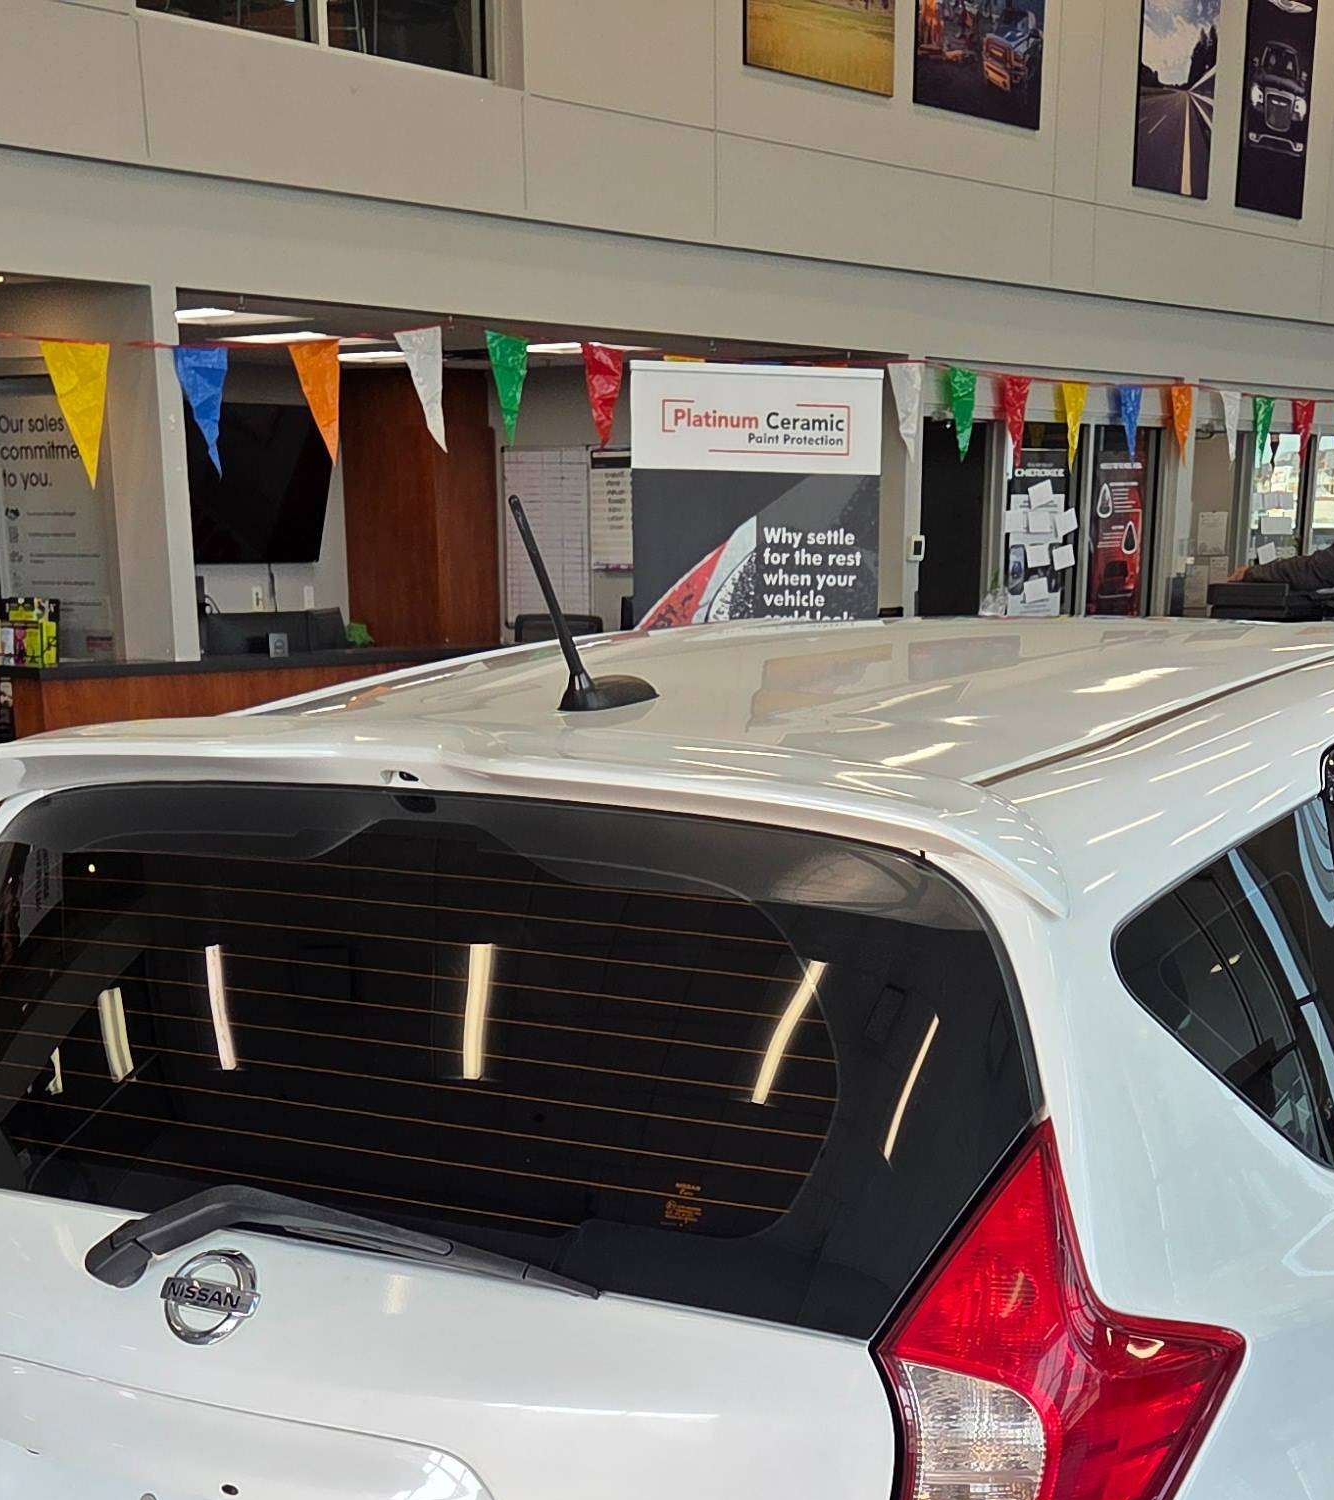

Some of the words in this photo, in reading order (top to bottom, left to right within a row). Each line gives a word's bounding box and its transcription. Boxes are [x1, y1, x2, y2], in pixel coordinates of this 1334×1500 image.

[28, 414, 65, 432] sales
[674, 408, 759, 429] Platinum
[766, 411, 845, 432] Ceramic
[748, 432, 779, 445] Paint
[783, 434, 844, 446] Protection
[0, 441, 80, 460] commitme
[3, 469, 17, 487] to
[20, 471, 53, 490] you.
[763, 526, 803, 548] Why
[807, 527, 856, 545] settle
[763, 547, 790, 565] for
[794, 548, 823, 566] the
[828, 551, 862, 567] rest
[763, 568, 811, 586] when
[816, 573, 857, 590] your
[763, 589, 825, 607] vehicle
[167, 1281, 241, 1308] NISSAN
